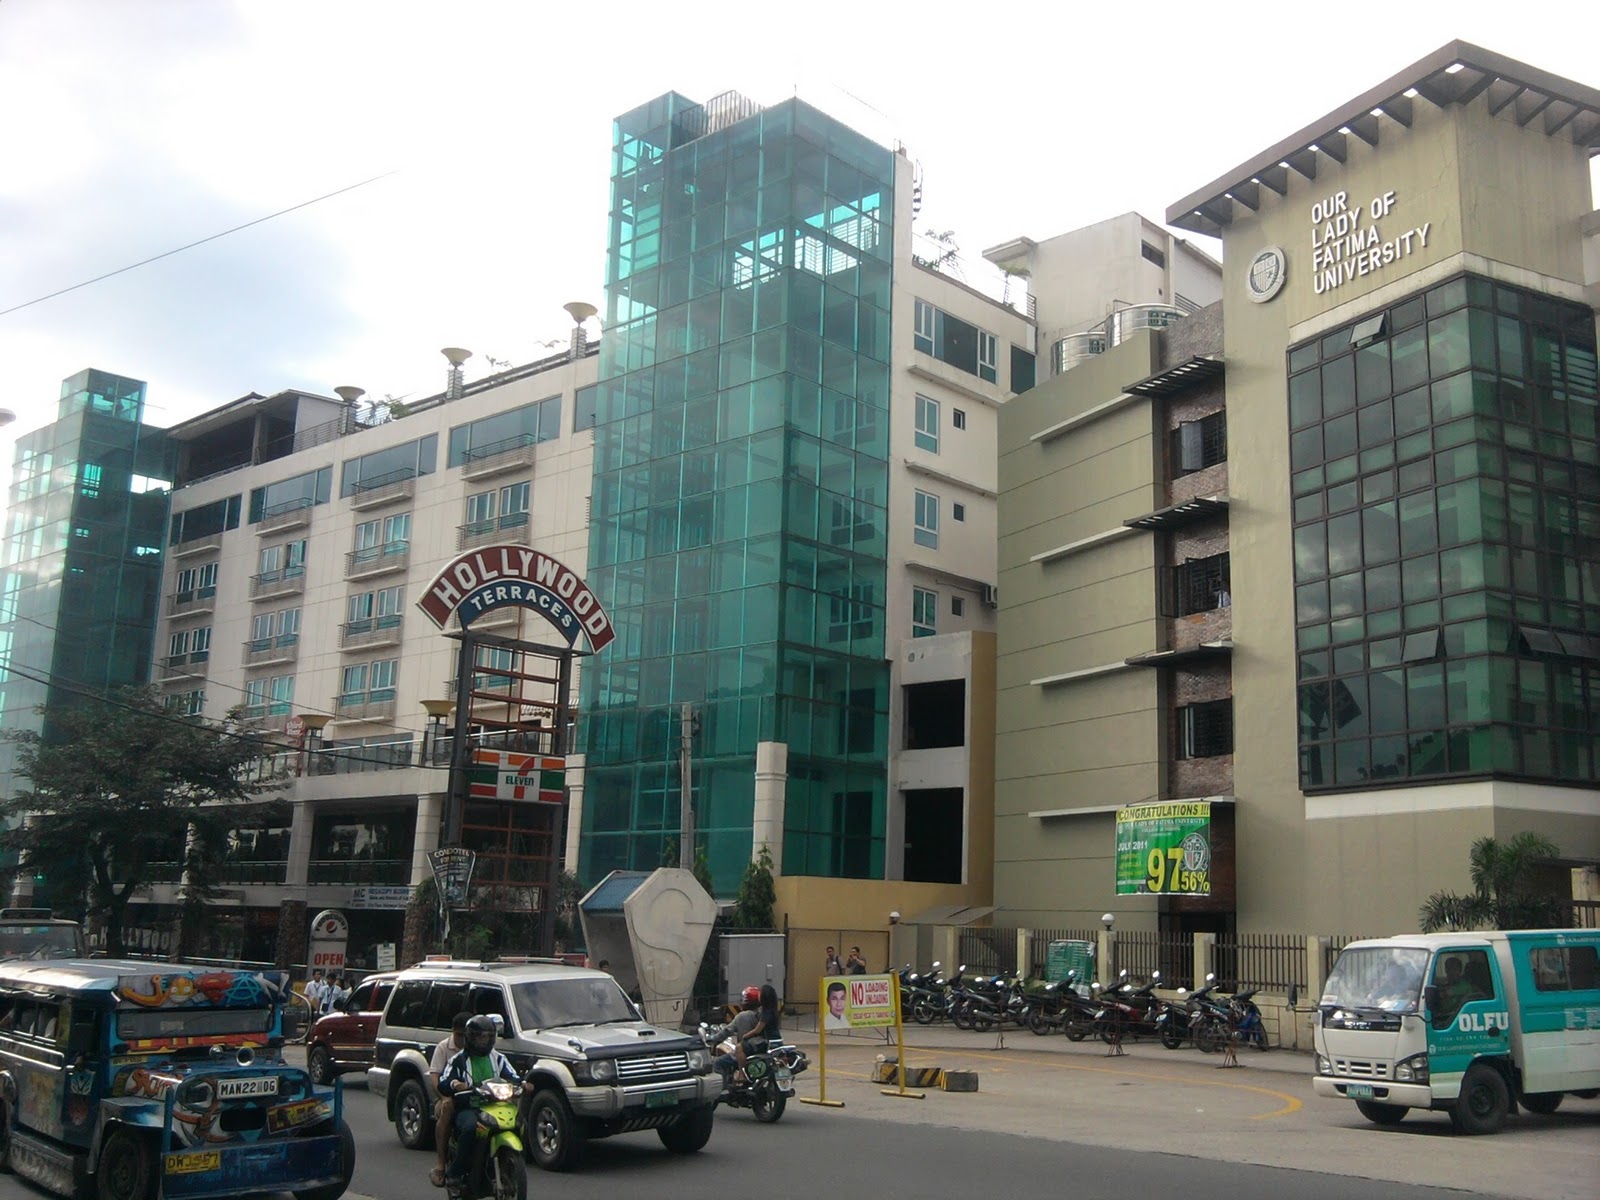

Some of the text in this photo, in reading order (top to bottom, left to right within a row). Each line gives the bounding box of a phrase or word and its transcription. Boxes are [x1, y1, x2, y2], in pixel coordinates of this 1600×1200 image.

[1311, 191, 1347, 224] OUR
[1312, 191, 1396, 249] LADY OF
[1312, 225, 1380, 272] FATIMA
[1313, 223, 1431, 294] UNIVERSITY
[432, 548, 607, 635] HOLLYWOOD
[470, 586, 573, 628] TERRACES
[508, 756, 535, 799] 7
[1119, 804, 1199, 821] CONGRATULATIONS
[434, 848, 469, 858] CONDOTEL
[1118, 841, 1148, 851] JULY 2011
[1147, 847, 1184, 892] 97
[314, 953, 344, 965] OPEN
[851, 982, 888, 1006] NO LOADING
[1458, 1011, 1509, 1032] OLFU
